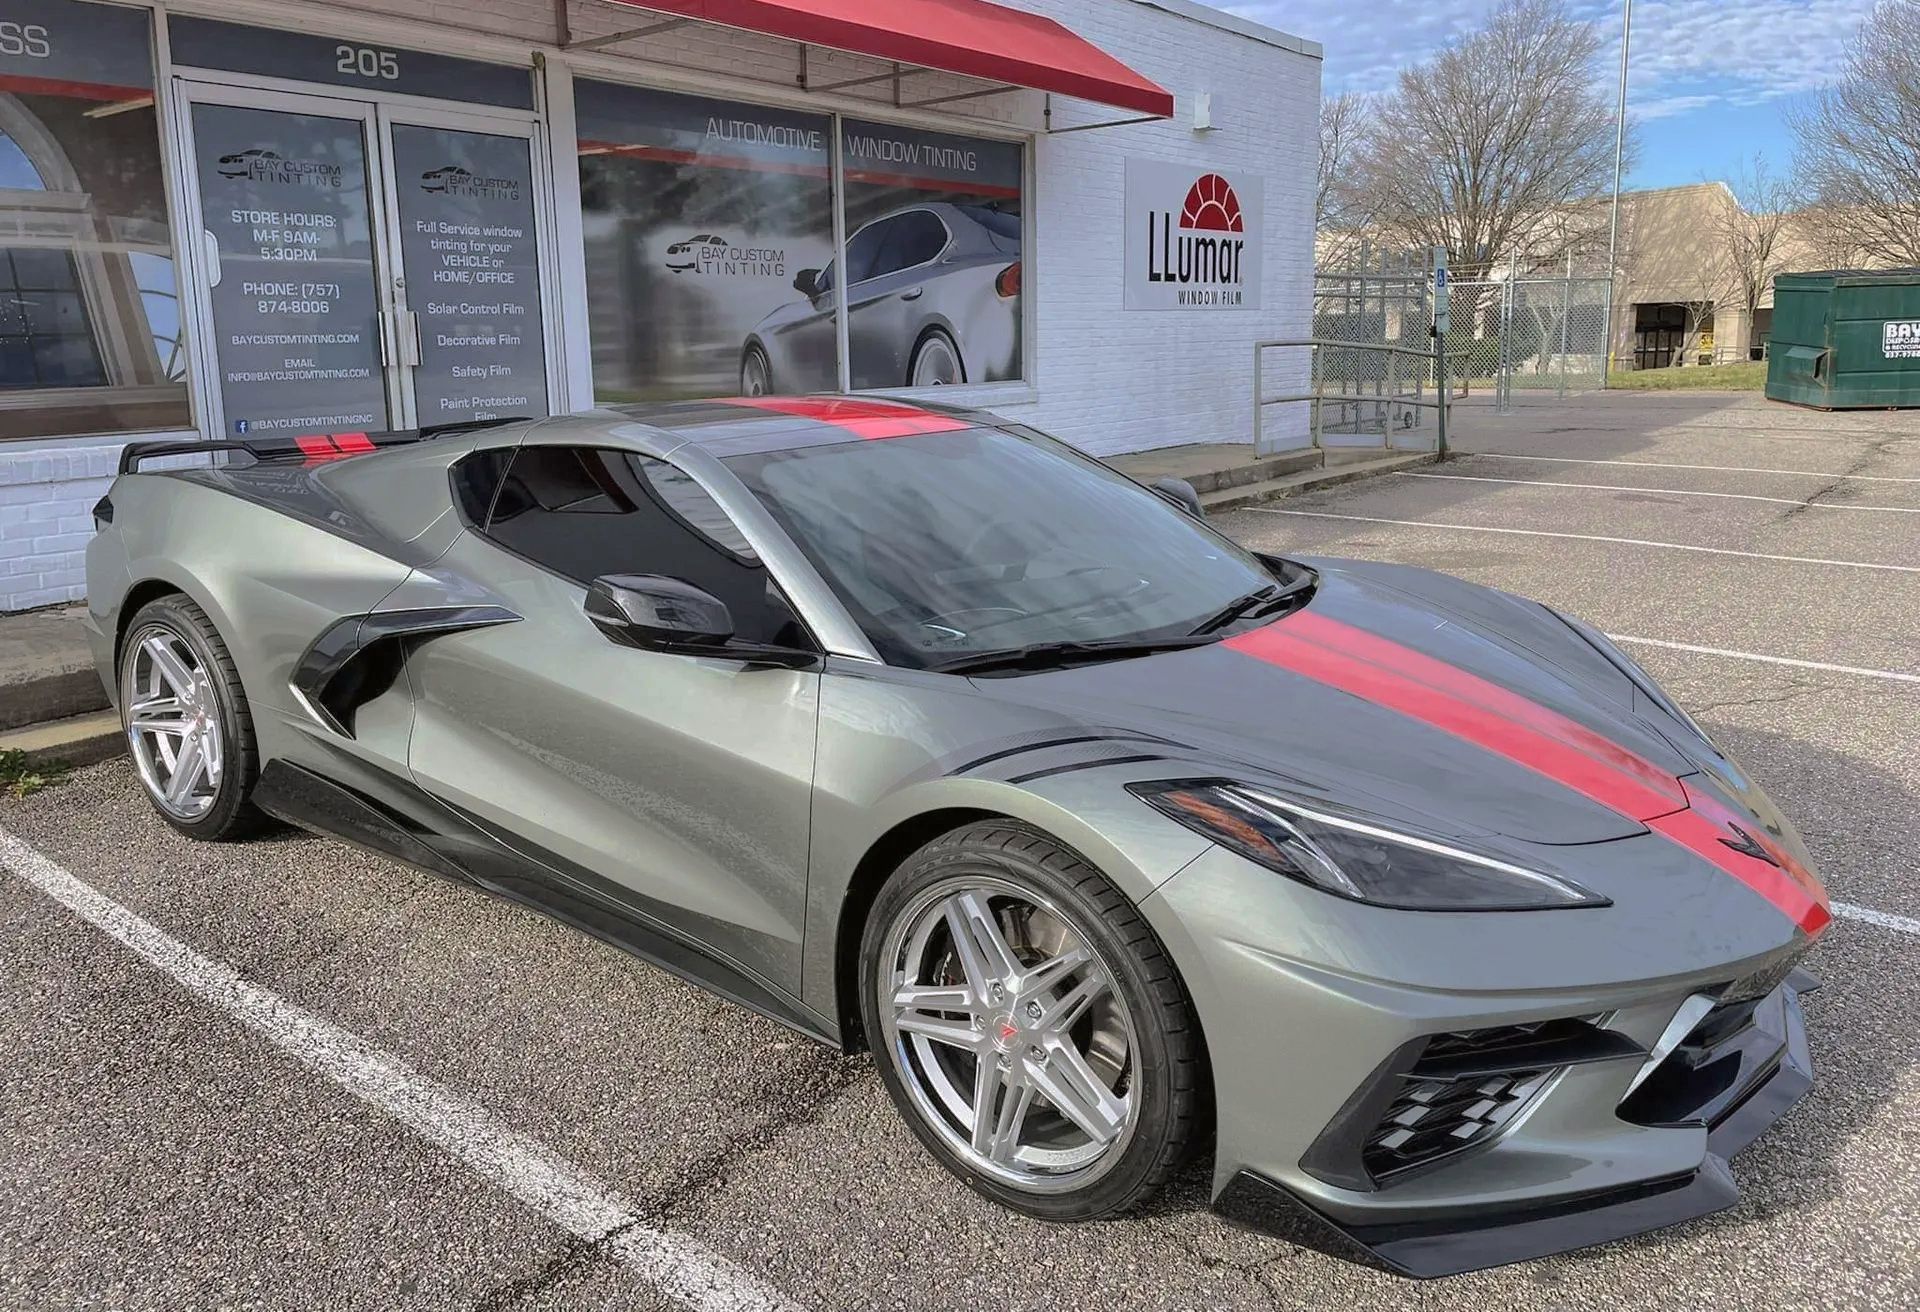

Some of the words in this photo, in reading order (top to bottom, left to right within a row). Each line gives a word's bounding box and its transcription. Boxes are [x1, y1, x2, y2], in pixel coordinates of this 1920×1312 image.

[336, 45, 399, 80] 205
[706, 117, 821, 151] AUTOMOTIVE
[847, 134, 920, 164] WINDOW
[923, 145, 977, 172] TINTING
[254, 159, 280, 170] BAY
[284, 161, 341, 175] CUSTOM
[256, 170, 342, 188] TINTING
[449, 175, 470, 185] BAY
[473, 177, 519, 190] CUSTOM
[452, 185, 519, 201] TINTING
[232, 209, 281, 225] STORE
[284, 213, 337, 228] HOURS:
[253, 229, 280, 243] M-F
[284, 230, 321, 244] 9AM-
[416, 220, 436, 233] Full
[439, 221, 480, 236] Service
[483, 224, 522, 238] window
[431, 238, 467, 254] tinting
[470, 239, 485, 252] for
[488, 243, 512, 255] your
[701, 246, 727, 260] BAY
[731, 247, 784, 262] CUSTOM
[1149, 211, 1243, 284] LLumar
[261, 247, 317, 262] 5:30PM
[442, 254, 489, 268] VEHICLE
[492, 259, 504, 268] or
[703, 261, 785, 277] TINTING
[433, 270, 515, 285] HOME/OFFICE
[243, 282, 298, 297] PHONE:
[301, 283, 340, 299] (757)
[1178, 290, 1218, 305] WINDOW
[1222, 291, 1242, 305] FILM
[257, 300, 330, 314] 874-8006
[427, 302, 457, 315] Solar
[460, 302, 500, 315] Control
[503, 303, 525, 315] Film
[232, 334, 360, 345] BAYCUSTOMTINTING.COM
[437, 334, 496, 346] Decorative
[499, 333, 521, 345] Film
[285, 359, 316, 369] EMAIL
[452, 365, 488, 379] Safety
[490, 364, 512, 376] Film
[228, 368, 370, 383] INFO@BAYCUSTOMTINTING.COM
[440, 398, 469, 410] Paint
[472, 396, 527, 408] Protection
